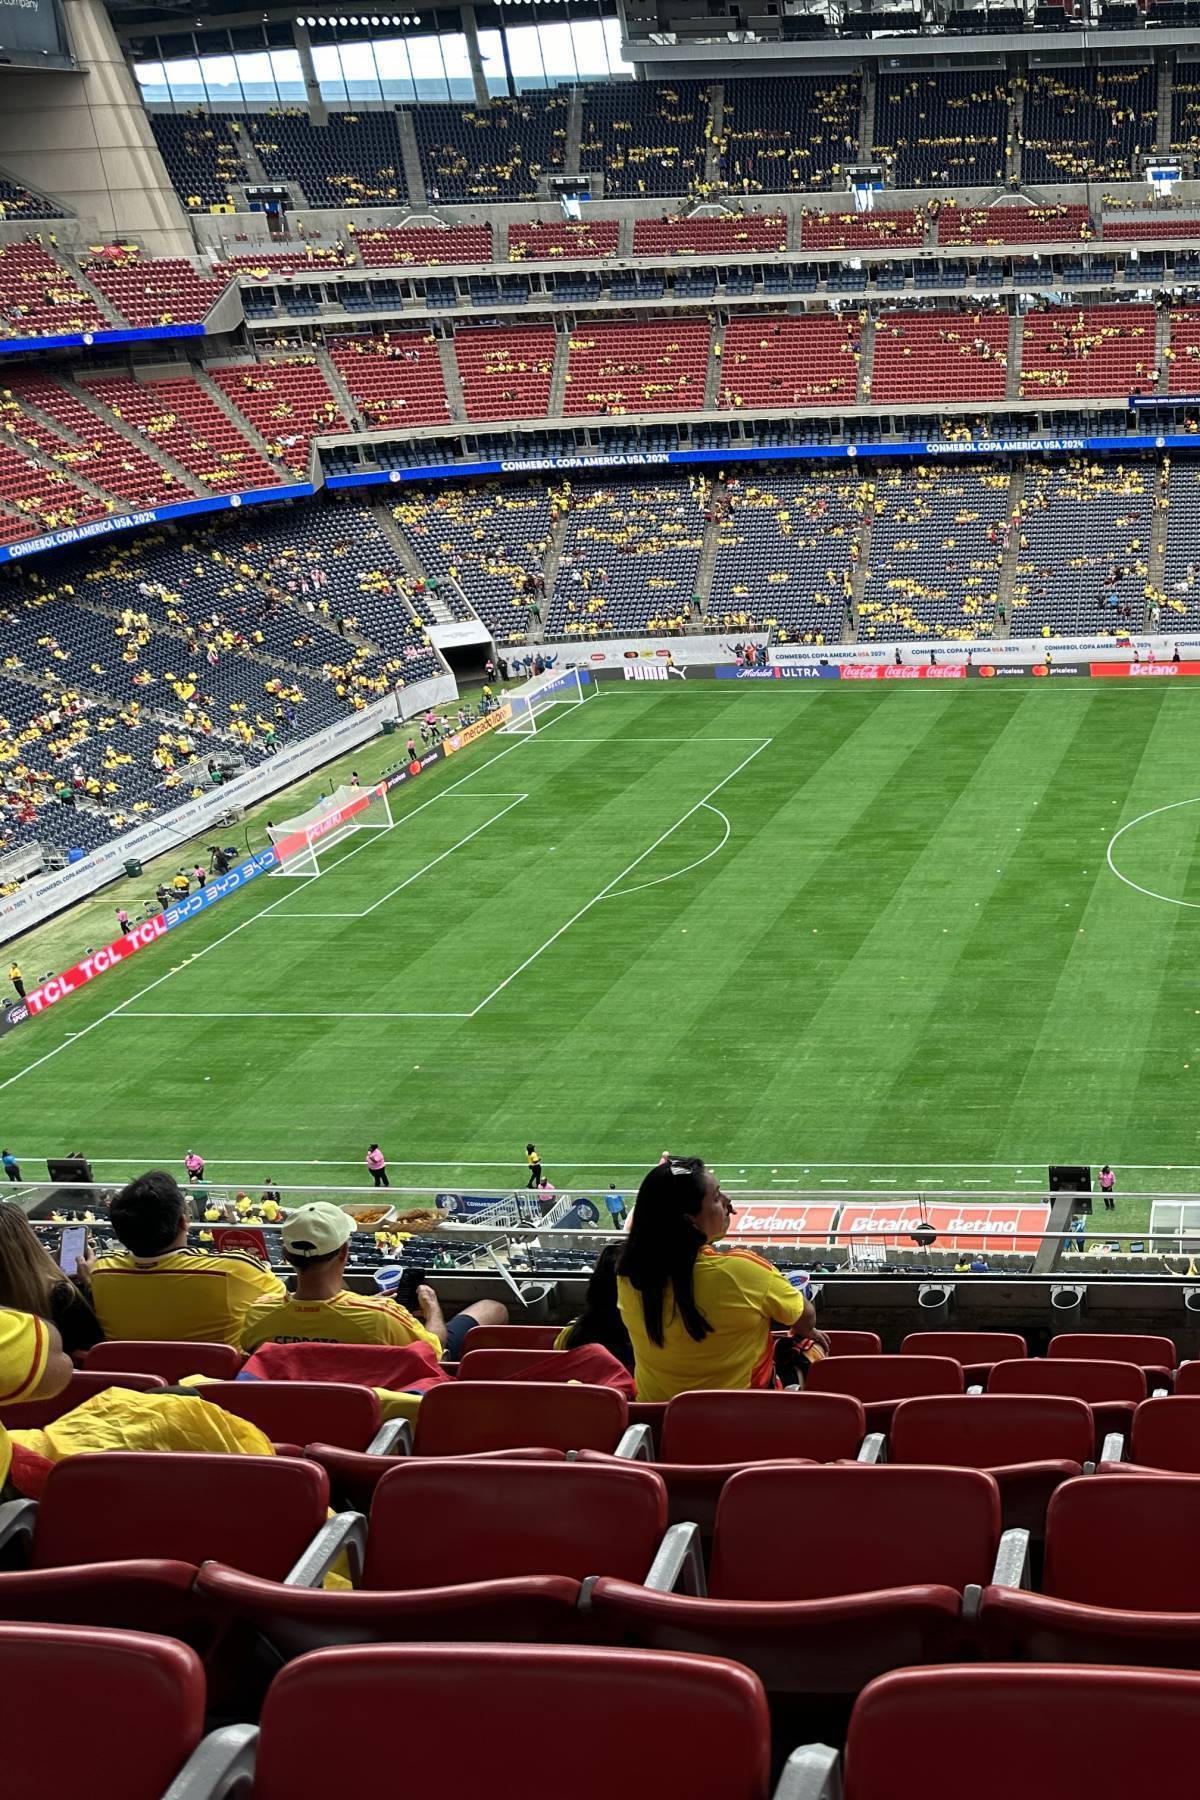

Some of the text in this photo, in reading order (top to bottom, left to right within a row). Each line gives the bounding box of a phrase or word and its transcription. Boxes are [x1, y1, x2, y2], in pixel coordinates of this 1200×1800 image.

[926, 439, 1084, 452] CONMEBOL COPA AMERICA USA 2024
[501, 453, 669, 470] CONMEBOL COPA AMERICA USA 2024
[9, 511, 156, 557] CONMEBOL COPA AMERICA USA 2024
[623, 666, 669, 681] PUMA
[736, 668, 820, 678] Michelob ULTRA
[996, 667, 1024, 675] priceless
[1050, 667, 1077, 675] priceless
[1129, 663, 1178, 675] Betano
[464, 719, 492, 742] mercado
[242, 851, 274, 878] BYD
[36, 880, 62, 897] CONMEBOL
[63, 873, 76, 884] COPA
[75, 863, 95, 877] AMERICA
[205, 874, 240, 901] BYD
[165, 897, 202, 925] BYD
[127, 921, 167, 951] TCL
[79, 947, 122, 978] TCL
[27, 974, 75, 1011] TCL
[736, 1216, 806, 1232] Betano
[850, 1217, 923, 1232] Betano
[948, 1219, 1016, 1232] Betano
